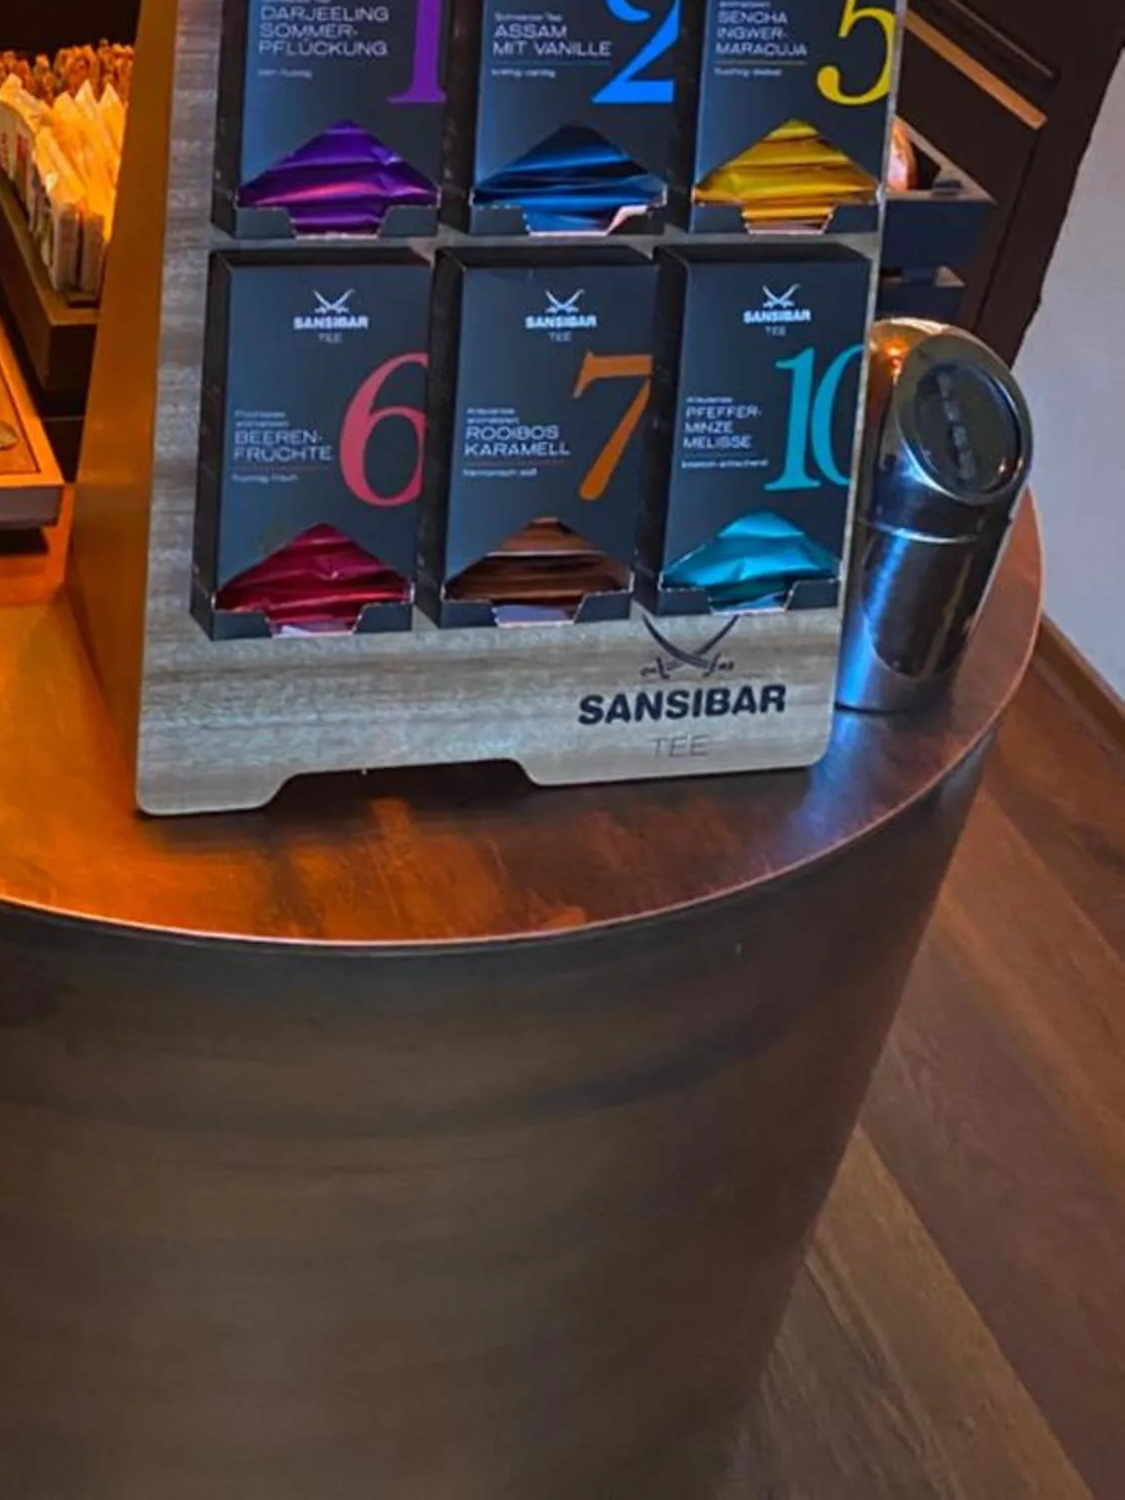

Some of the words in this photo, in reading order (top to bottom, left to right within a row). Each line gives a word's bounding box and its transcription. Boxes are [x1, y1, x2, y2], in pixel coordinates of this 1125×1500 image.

[260, 5, 390, 23] DARJEELING
[717, 9, 788, 25] SENCHA
[259, 22, 358, 39] SOMMER-
[493, 22, 569, 40] ASSAM
[492, 40, 528, 56] MIT
[532, 39, 613, 57] VANILLE
[714, 41, 808, 57] MARACUJA
[293, 315, 369, 331] SANSIBAR
[525, 315, 598, 329] SANSIBAR
[743, 310, 812, 325] SANSIBAR
[548, 331, 572, 342] TEE
[339, 351, 429, 507] 6
[465, 424, 559, 441] ROOIBOS
[573, 351, 653, 501] 7
[684, 419, 734, 434] MINZE
[463, 440, 571, 457] KARAMELL
[682, 434, 753, 450] MELISSE
[578, 684, 787, 725] SANSIBAR
[648, 734, 712, 758] TEE
